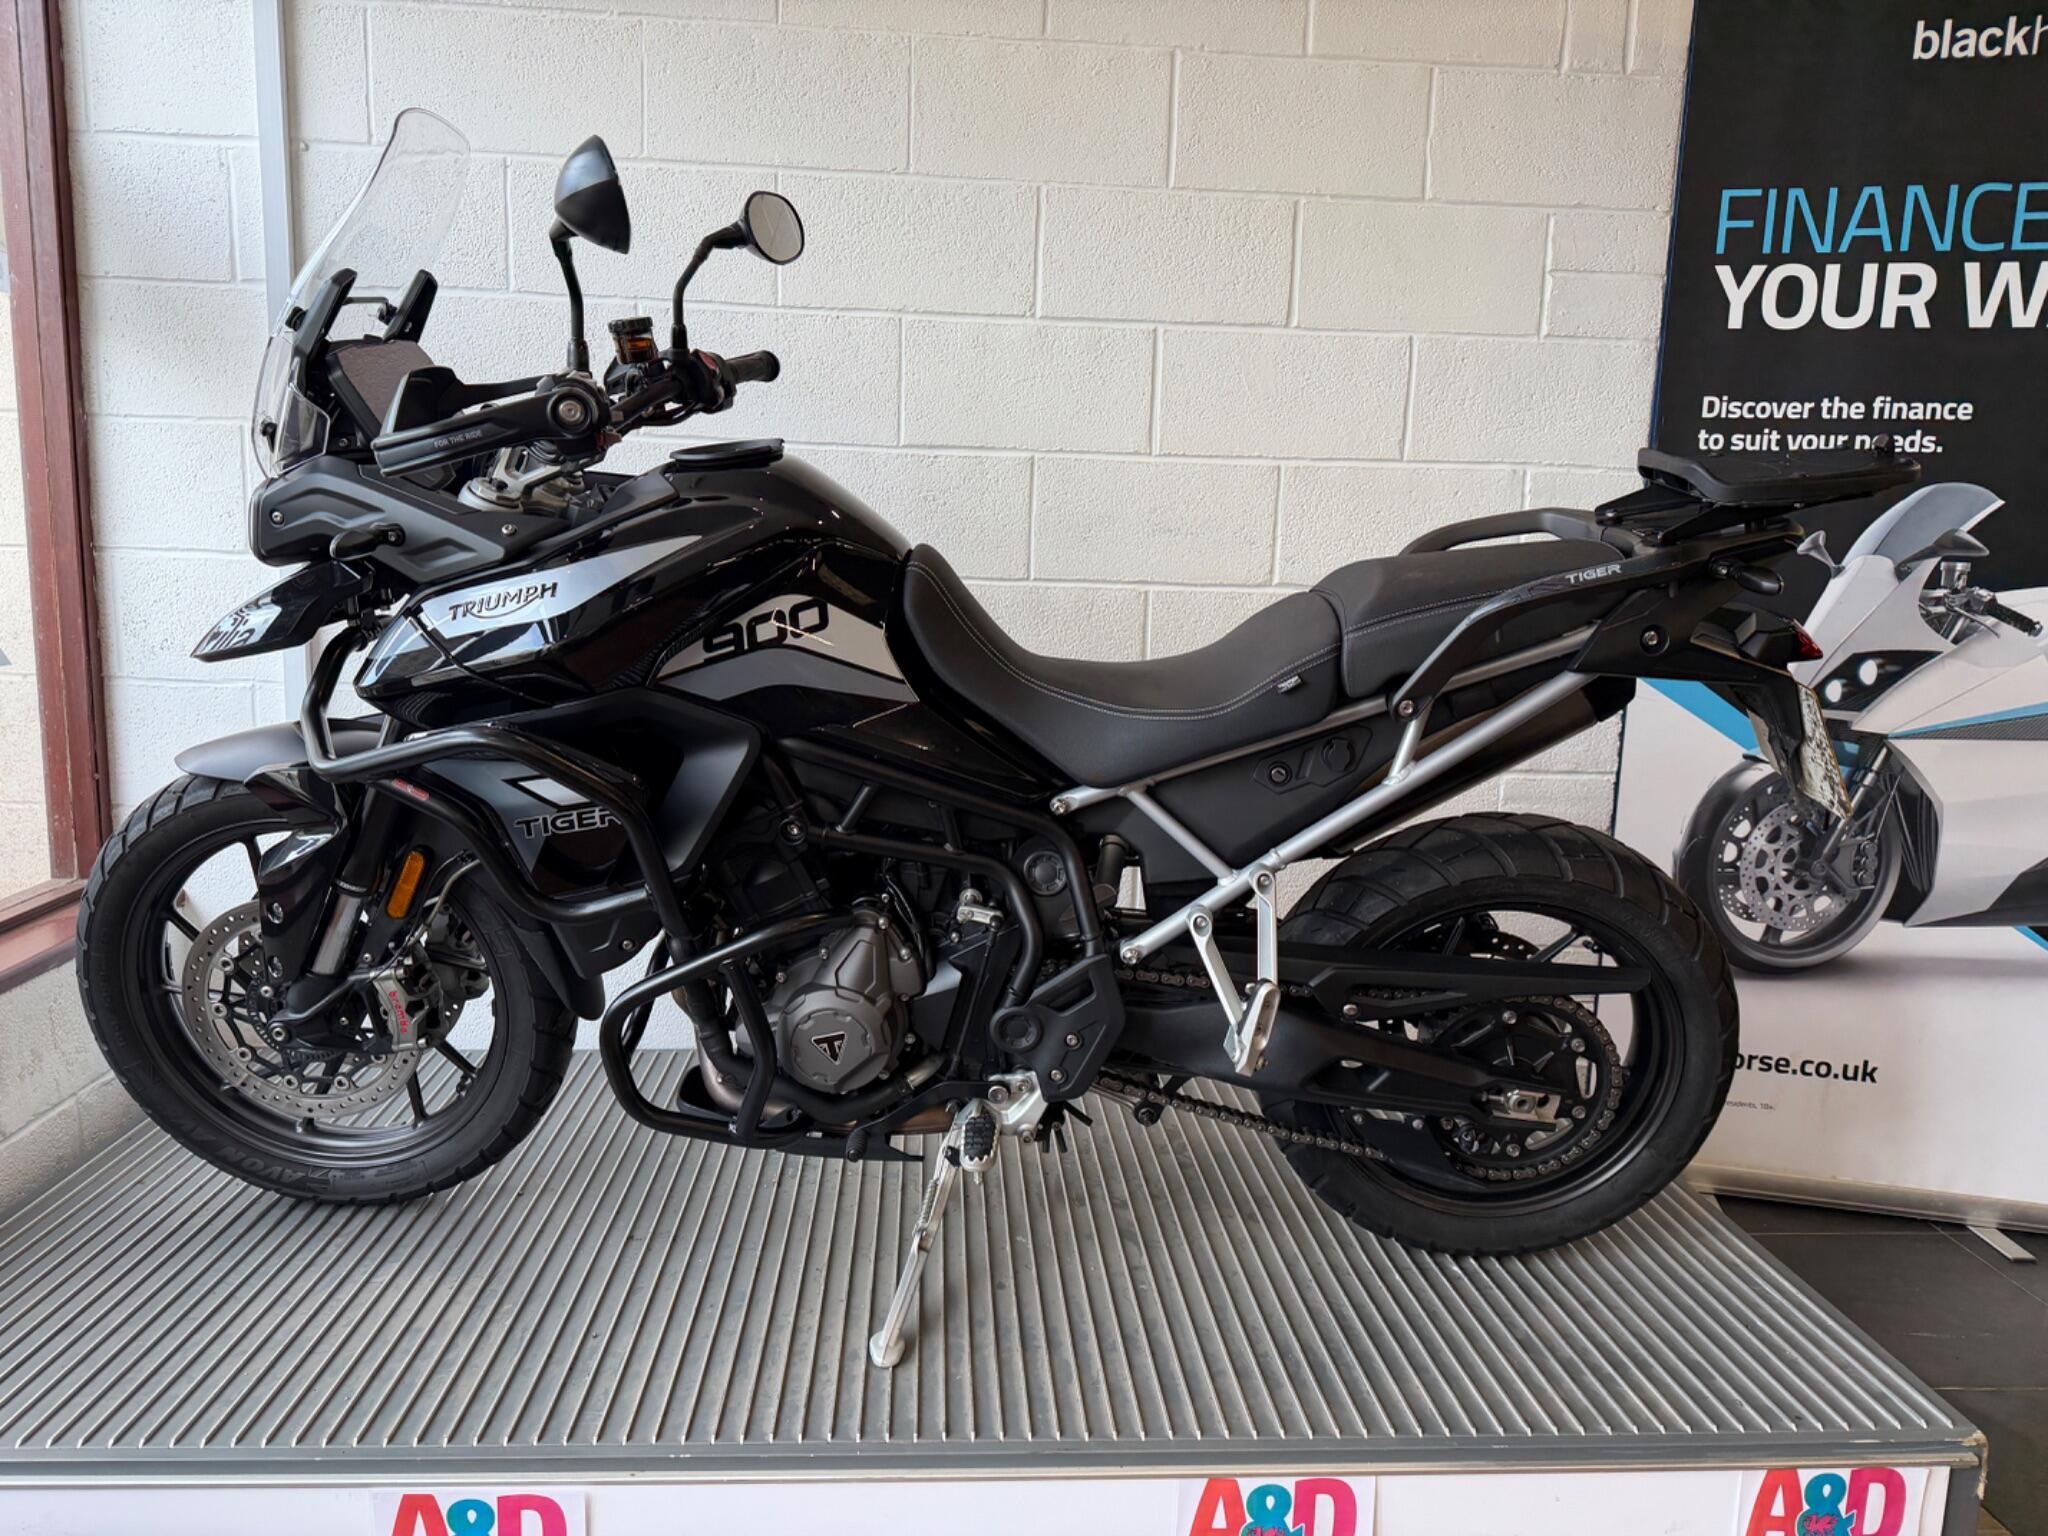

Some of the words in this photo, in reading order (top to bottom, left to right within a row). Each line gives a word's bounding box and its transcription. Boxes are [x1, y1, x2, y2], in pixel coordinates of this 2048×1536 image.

[1715, 181, 2048, 254] FINANCE
[1714, 262, 1938, 330] YOUR
[1963, 260, 2048, 329] W
[1701, 395, 1814, 419] Discover
[1821, 396, 1865, 420] the
[1872, 396, 1974, 421] finance
[1698, 428, 1724, 451] to
[1730, 428, 1781, 451] suit
[1854, 429, 1943, 453] neds.
[1565, 564, 1621, 584] TIGER
[449, 582, 558, 621] TRIUMPH
[702, 598, 829, 661] 900
[1746, 1467, 1906, 1536] A&D
